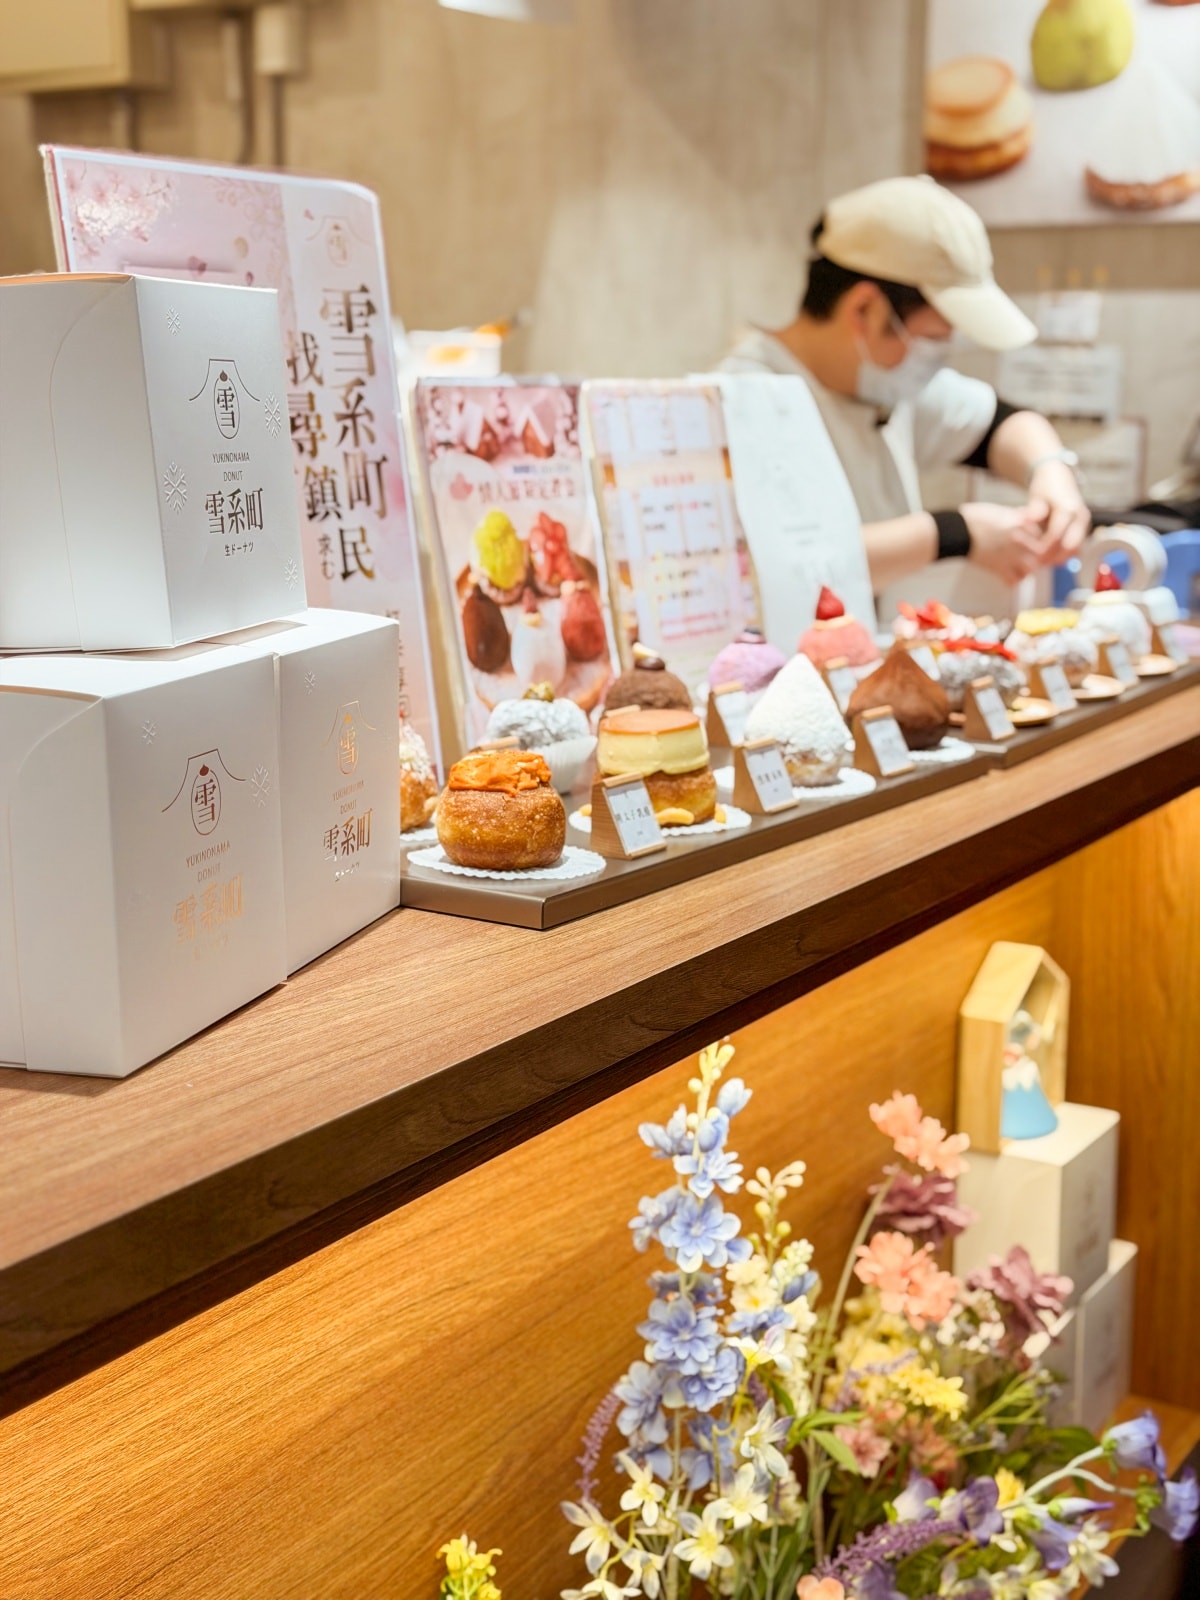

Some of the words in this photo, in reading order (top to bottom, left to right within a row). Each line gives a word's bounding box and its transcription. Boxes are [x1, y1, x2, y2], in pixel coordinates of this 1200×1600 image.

[216, 386, 235, 429] 雪
[212, 451, 250, 464] YUKINONAMA
[223, 470, 243, 482] DONUT
[204, 487, 265, 535] 雪系町
[224, 541, 254, 557] 生ドーナツ
[194, 778, 217, 825] 雪
[339, 799, 357, 815] DONUT
[322, 807, 374, 863] 雪系町
[185, 839, 231, 869] YUKINONAMA
[196, 862, 222, 883] DONUT
